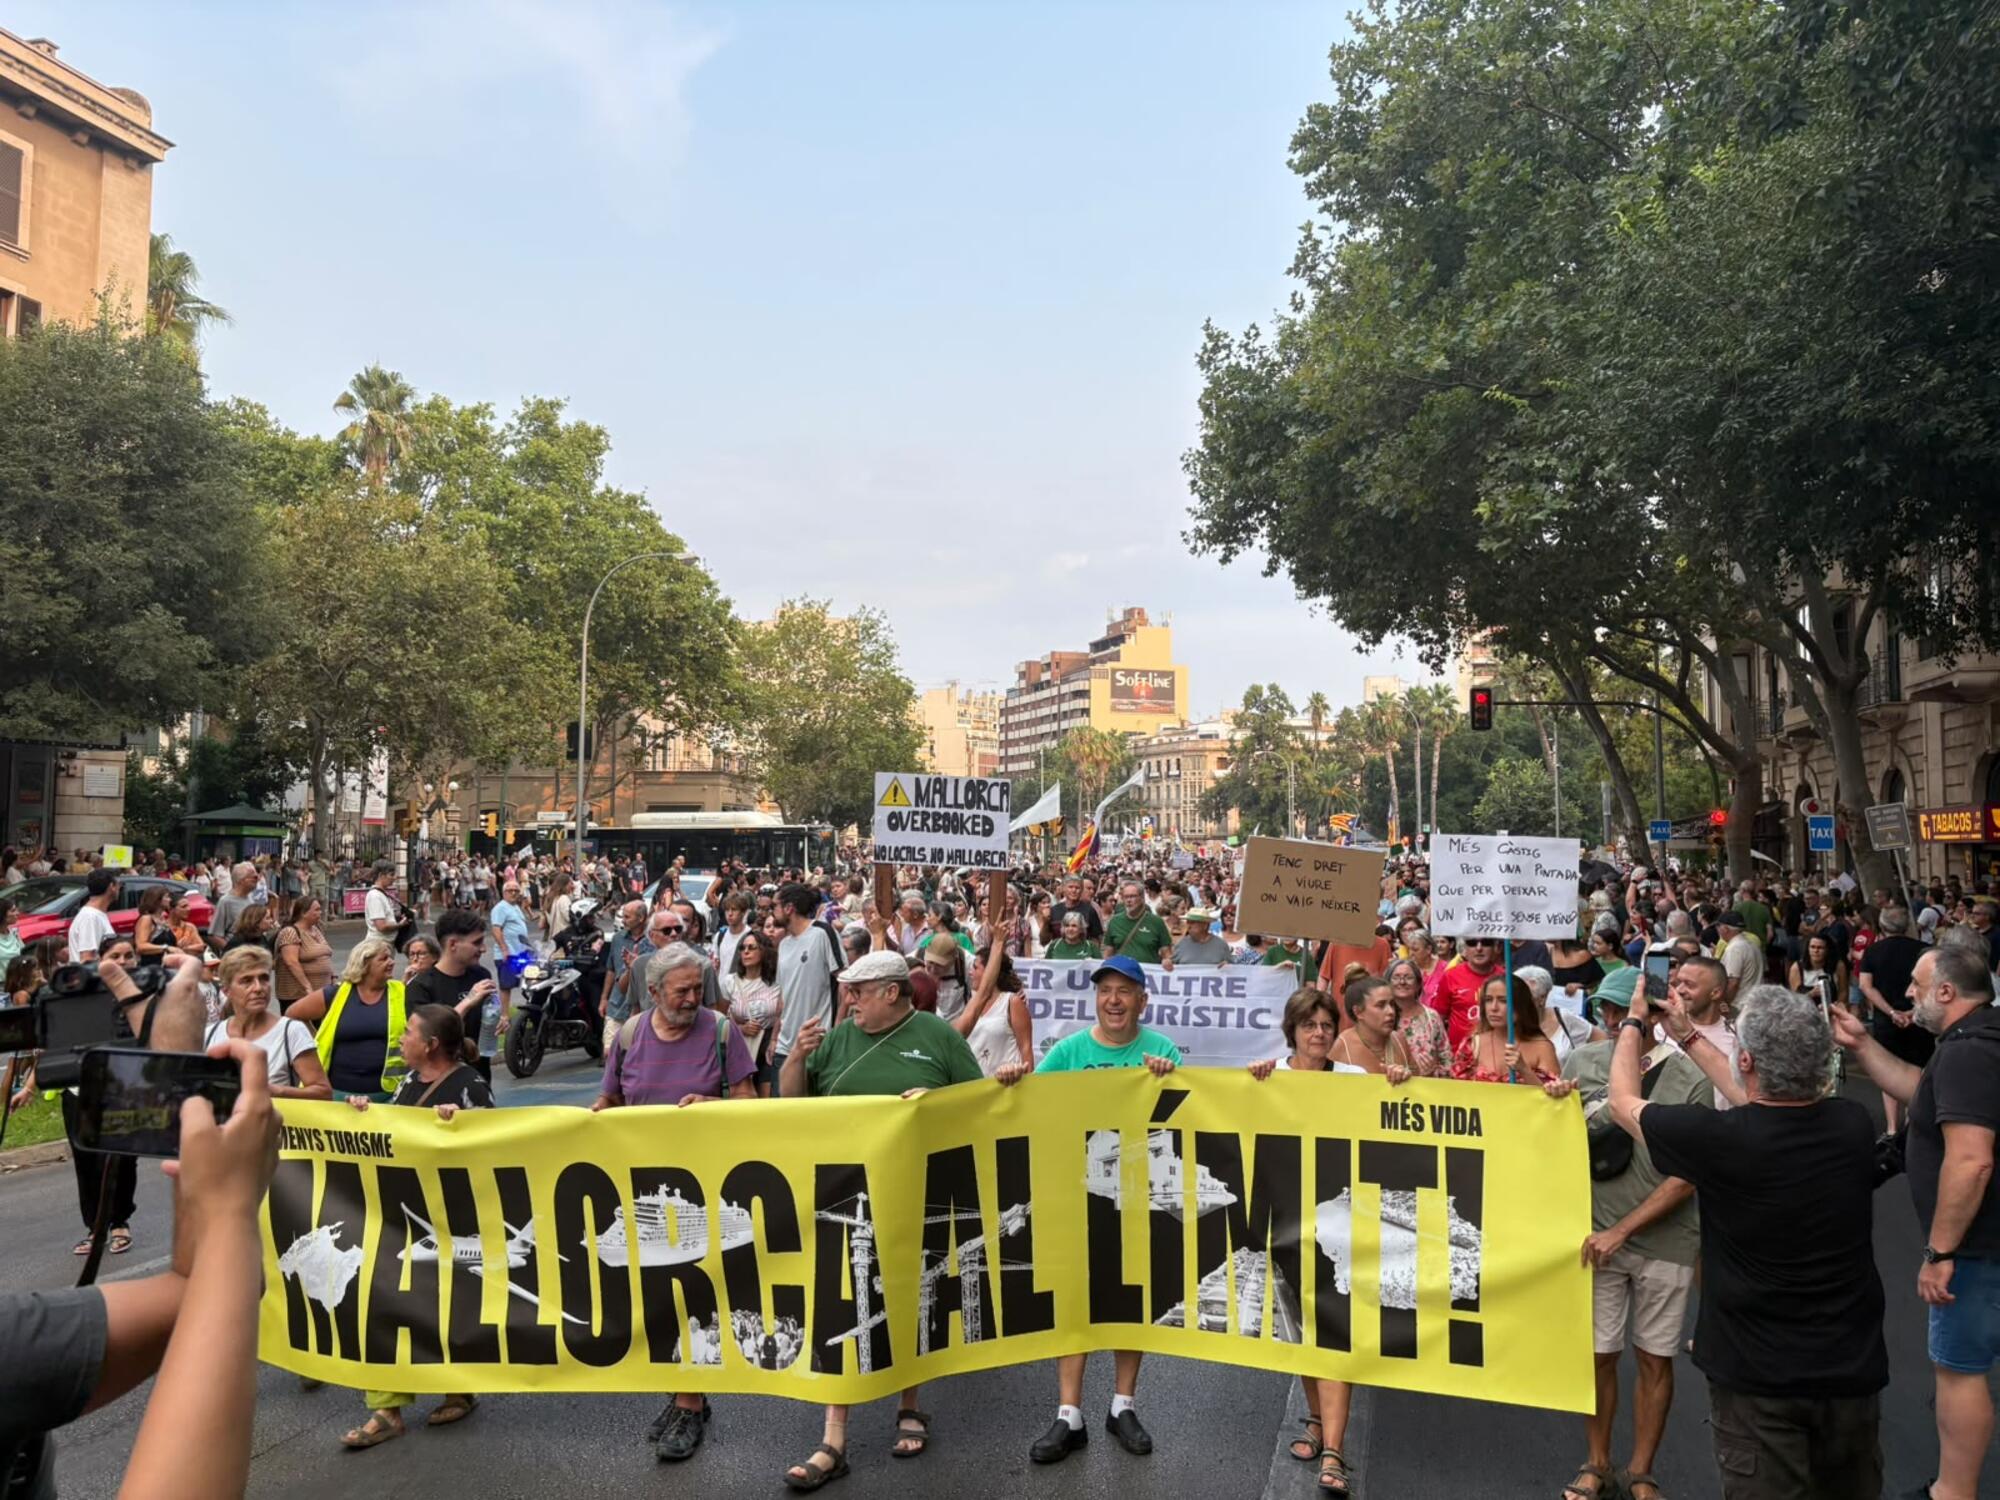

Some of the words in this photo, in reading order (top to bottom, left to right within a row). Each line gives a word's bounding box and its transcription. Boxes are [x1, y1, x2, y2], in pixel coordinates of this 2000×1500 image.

[914, 777, 1010, 812] MALLORCA
[887, 810, 994, 837] OVERBOOKED
[1931, 811, 1972, 833] TABACOS
[1811, 828, 1834, 839] TAXI
[874, 845, 887, 861] NO
[930, 847, 944, 864] NO
[947, 848, 1006, 868] MALLORCA
[1272, 853, 1303, 868] TENC
[1314, 861, 1346, 875] DRET
[1460, 863, 1483, 875] PER
[1499, 864, 1521, 875] UNA
[1273, 875, 1282, 888] A
[1438, 884, 1464, 896] QUE
[1471, 884, 1494, 896] PER
[1502, 885, 1547, 897] DEIXAR
[1261, 893, 1277, 903] ON
[1286, 895, 1314, 907] VAIG
[1436, 908, 1454, 921] UN
[1466, 907, 1502, 922] POBLE
[1511, 911, 1541, 924] SENSE
[1014, 969, 1054, 990] ER
[1067, 970, 1096, 991] U
[1028, 998, 1096, 1020] DEL
[1139, 999, 1271, 1029] URÍSTIC
[1381, 1097, 1425, 1132] MÉS
[1430, 1105, 1483, 1137] VIDA
[324, 1130, 394, 1158] TURISME
[268, 1158, 892, 1376] MALLORCA
[917, 1135, 1054, 1357] AL
[1085, 1089, 1484, 1368] LÍMIT!
